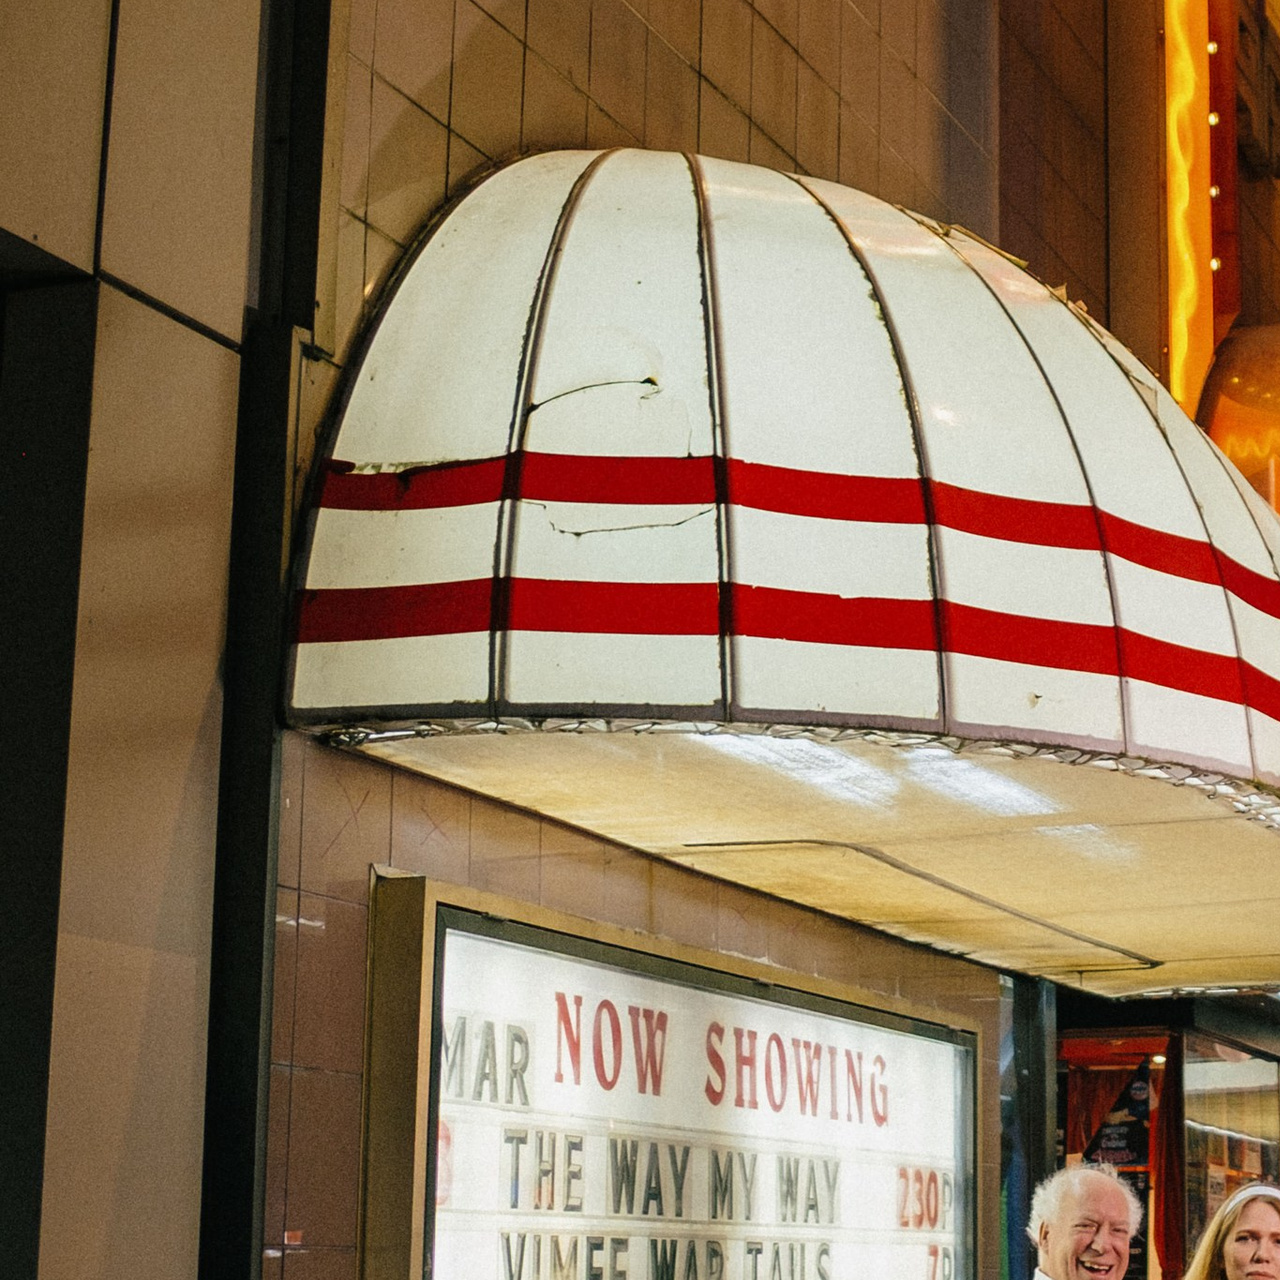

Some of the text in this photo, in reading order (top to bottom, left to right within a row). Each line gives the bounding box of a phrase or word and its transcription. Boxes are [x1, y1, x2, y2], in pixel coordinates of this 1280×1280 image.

[441, 1016, 531, 1106] MAR
[554, 991, 889, 1128] NOW SHOWING
[504, 1128, 584, 1212] THE
[609, 1138, 691, 1218] WAY
[711, 1149, 757, 1221] MY
[777, 1155, 841, 1224] WAY
